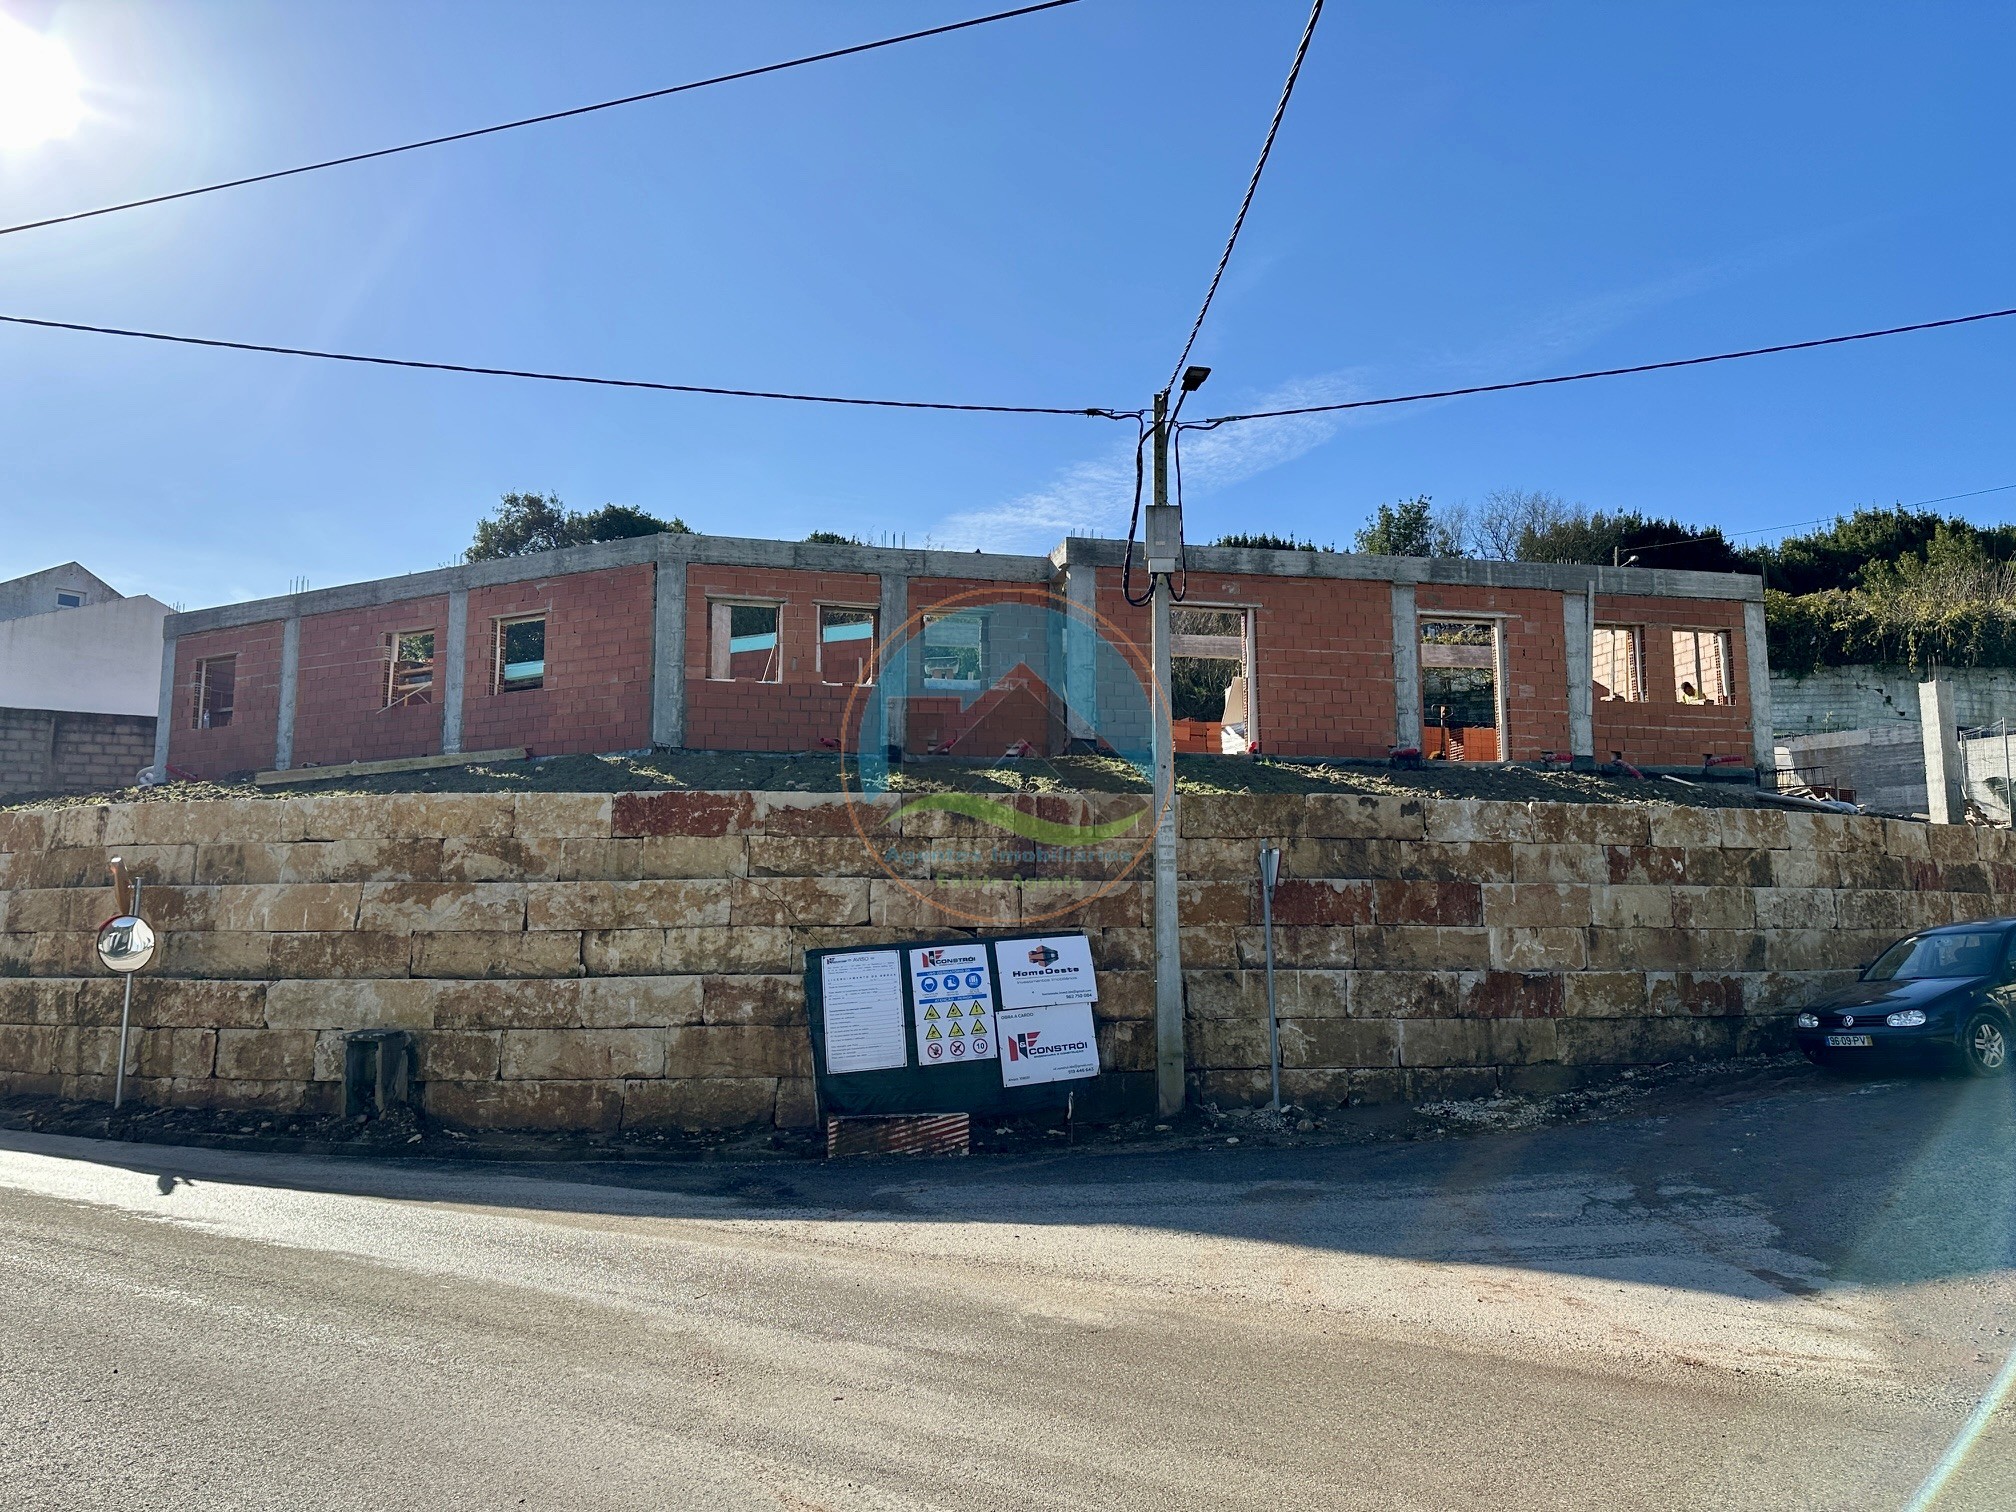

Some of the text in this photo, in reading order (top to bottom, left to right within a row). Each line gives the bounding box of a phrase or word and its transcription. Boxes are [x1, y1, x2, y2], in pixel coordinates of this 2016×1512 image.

[1012, 967, 1080, 978] HomeOeste
[976, 1042, 985, 1050] 10
[1029, 1041, 1088, 1055] CONSTRÓI
